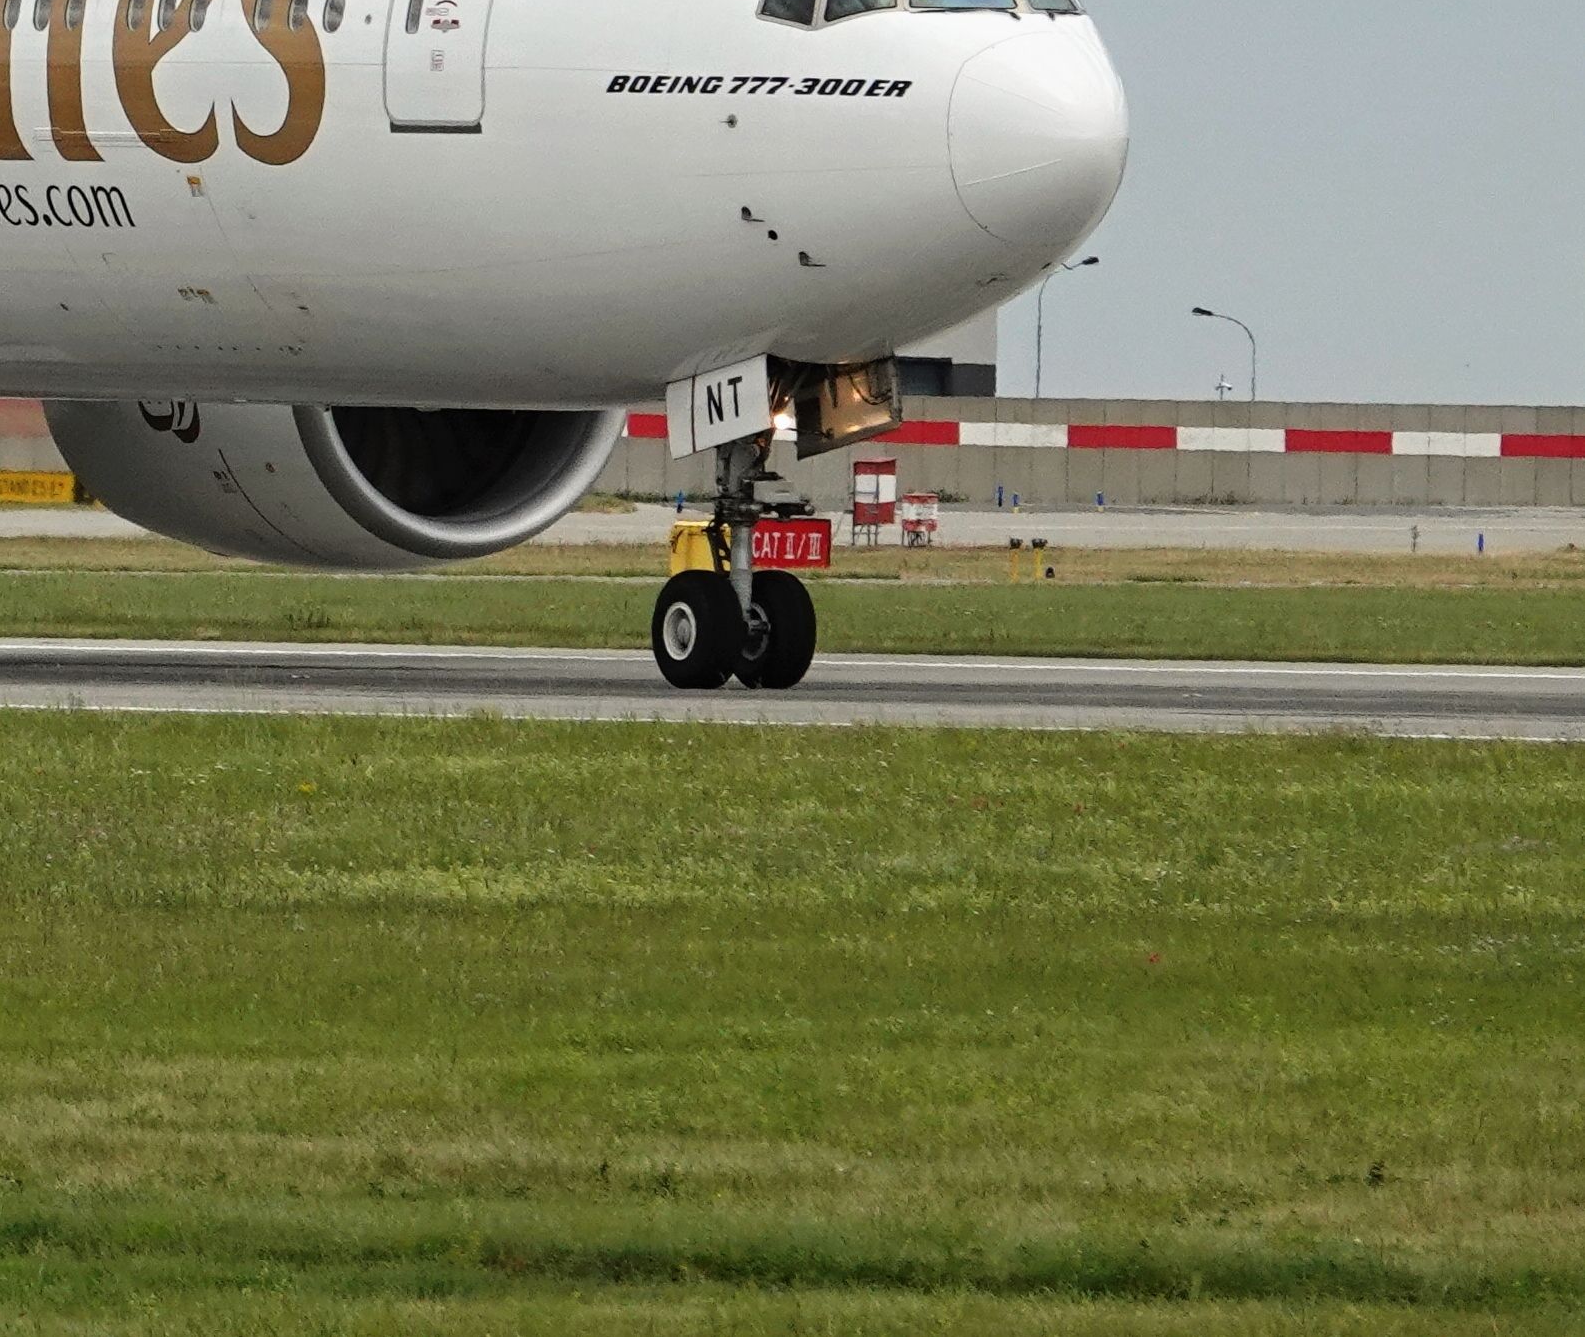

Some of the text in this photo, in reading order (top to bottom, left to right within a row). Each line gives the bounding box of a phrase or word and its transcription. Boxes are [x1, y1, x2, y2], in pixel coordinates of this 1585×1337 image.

[606, 75, 724, 94] BOEING
[706, 375, 743, 425] NT
[752, 531, 781, 559] CAT
